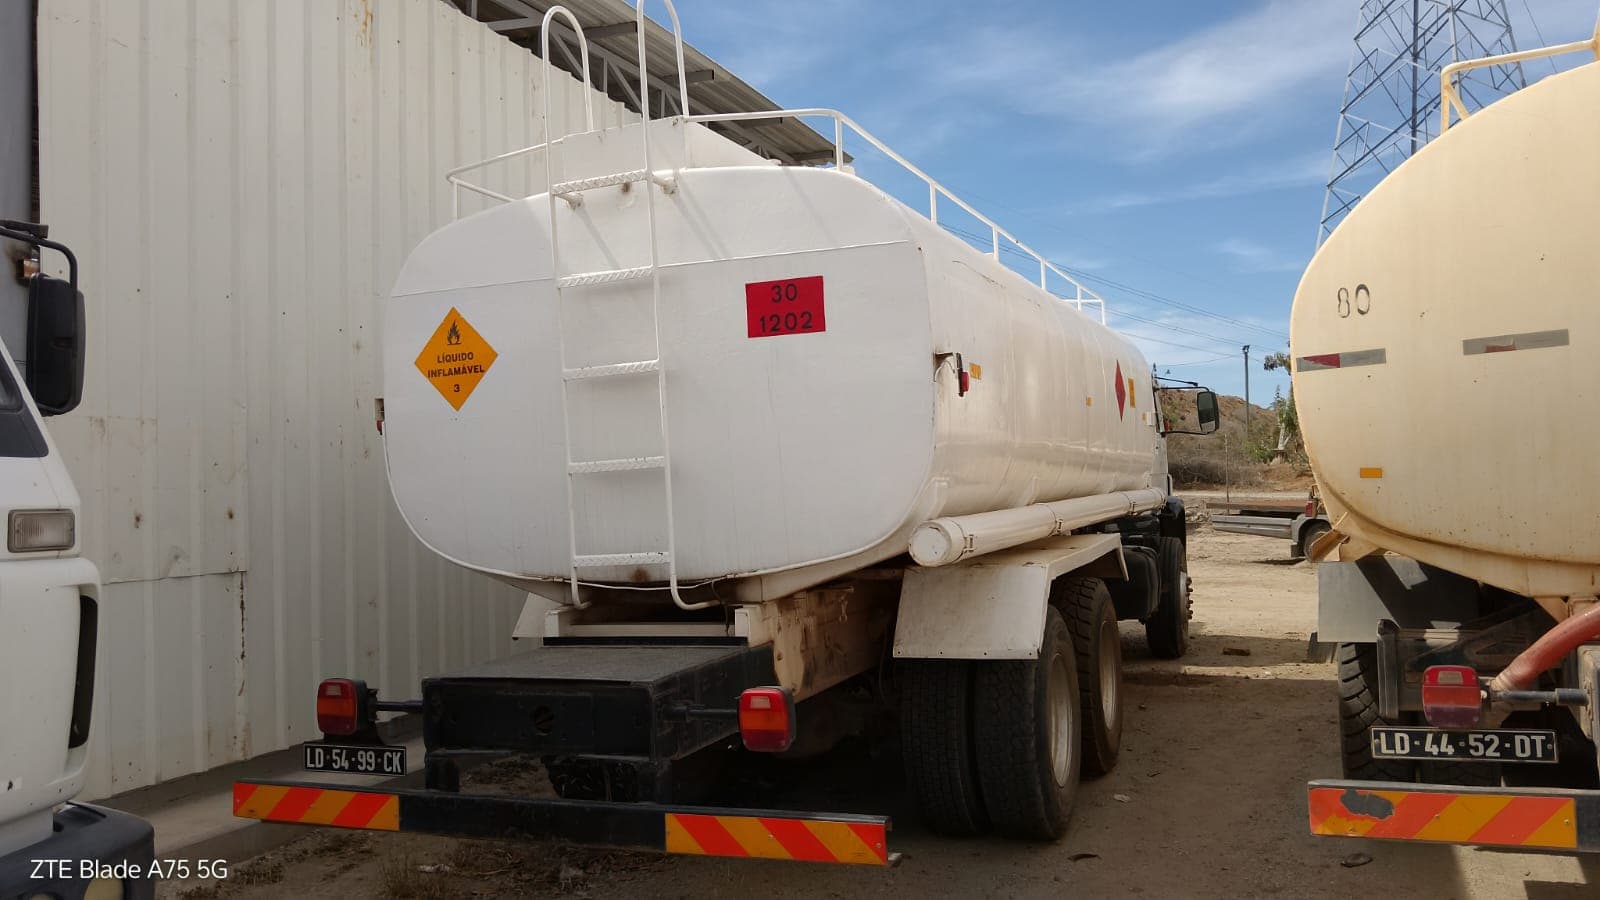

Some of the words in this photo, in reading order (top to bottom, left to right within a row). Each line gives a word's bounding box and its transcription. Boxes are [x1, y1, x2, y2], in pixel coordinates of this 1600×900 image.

[771, 283, 798, 303] 30
[1337, 283, 1371, 319] 80
[760, 311, 813, 334] 1202
[437, 351, 474, 364] LÍQUIDO
[427, 363, 486, 379] INFLAMÁVEL
[453, 383, 461, 393] 3
